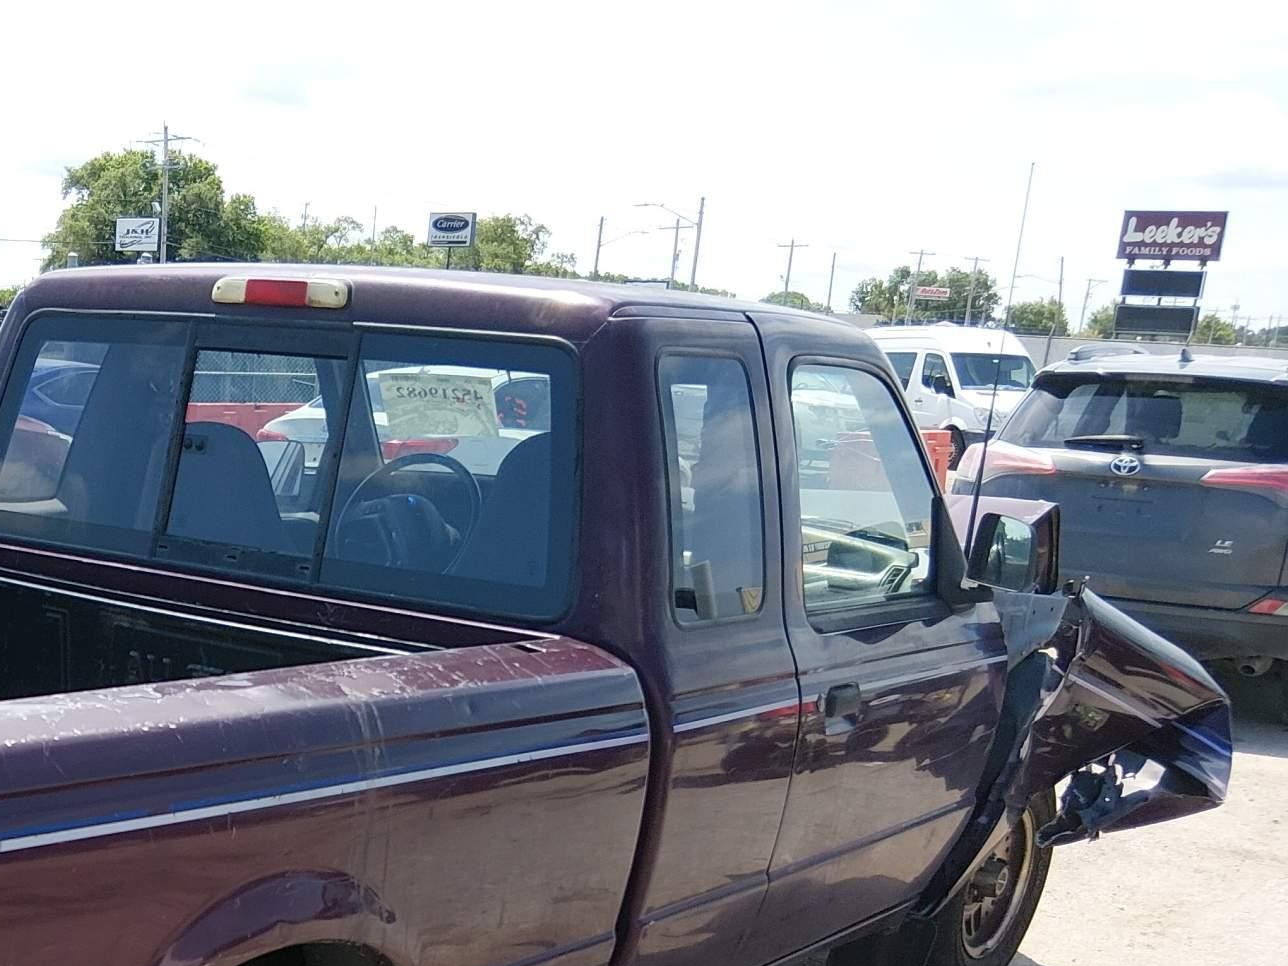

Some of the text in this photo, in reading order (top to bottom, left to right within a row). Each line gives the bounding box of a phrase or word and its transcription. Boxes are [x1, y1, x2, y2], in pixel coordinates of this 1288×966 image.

[436, 219, 465, 229] Carrier
[1123, 216, 1221, 245] Leeker's
[1125, 246, 1211, 256] FAMILY FOODS
